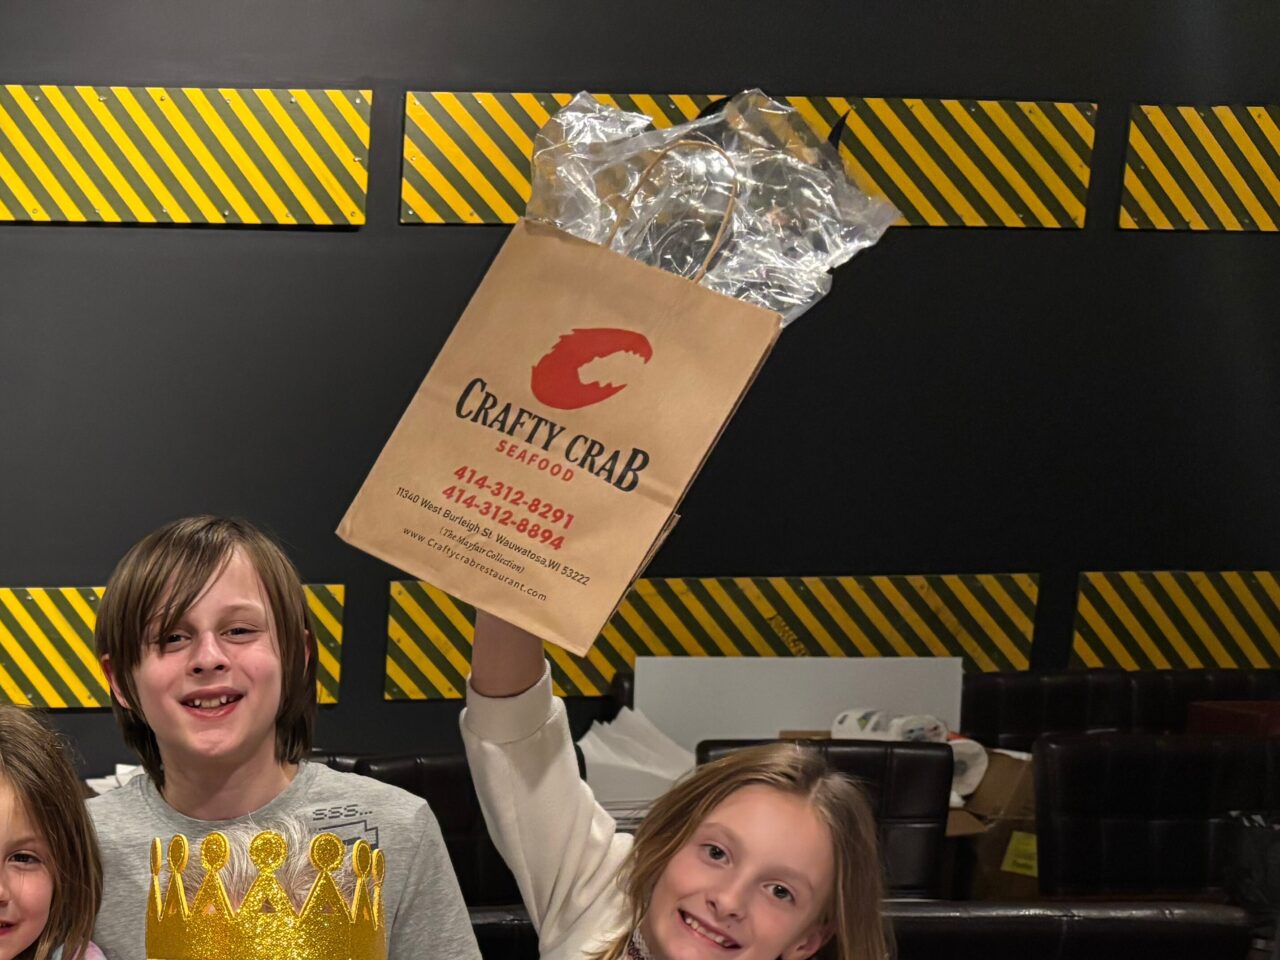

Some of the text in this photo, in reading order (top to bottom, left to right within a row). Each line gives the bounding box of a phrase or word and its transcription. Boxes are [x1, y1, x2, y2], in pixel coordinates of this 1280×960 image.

[455, 378, 650, 492] CRAFTY CRAB
[496, 439, 575, 482] SEAFOOD
[442, 485, 566, 550] 414-312-8894
[454, 466, 575, 530] 414-312-8291
[396, 487, 421, 504] 11340
[420, 498, 442, 514] West
[443, 509, 480, 533] Burleigh
[561, 566, 591, 586] 53222
[456, 535, 487, 551] Mayfair
